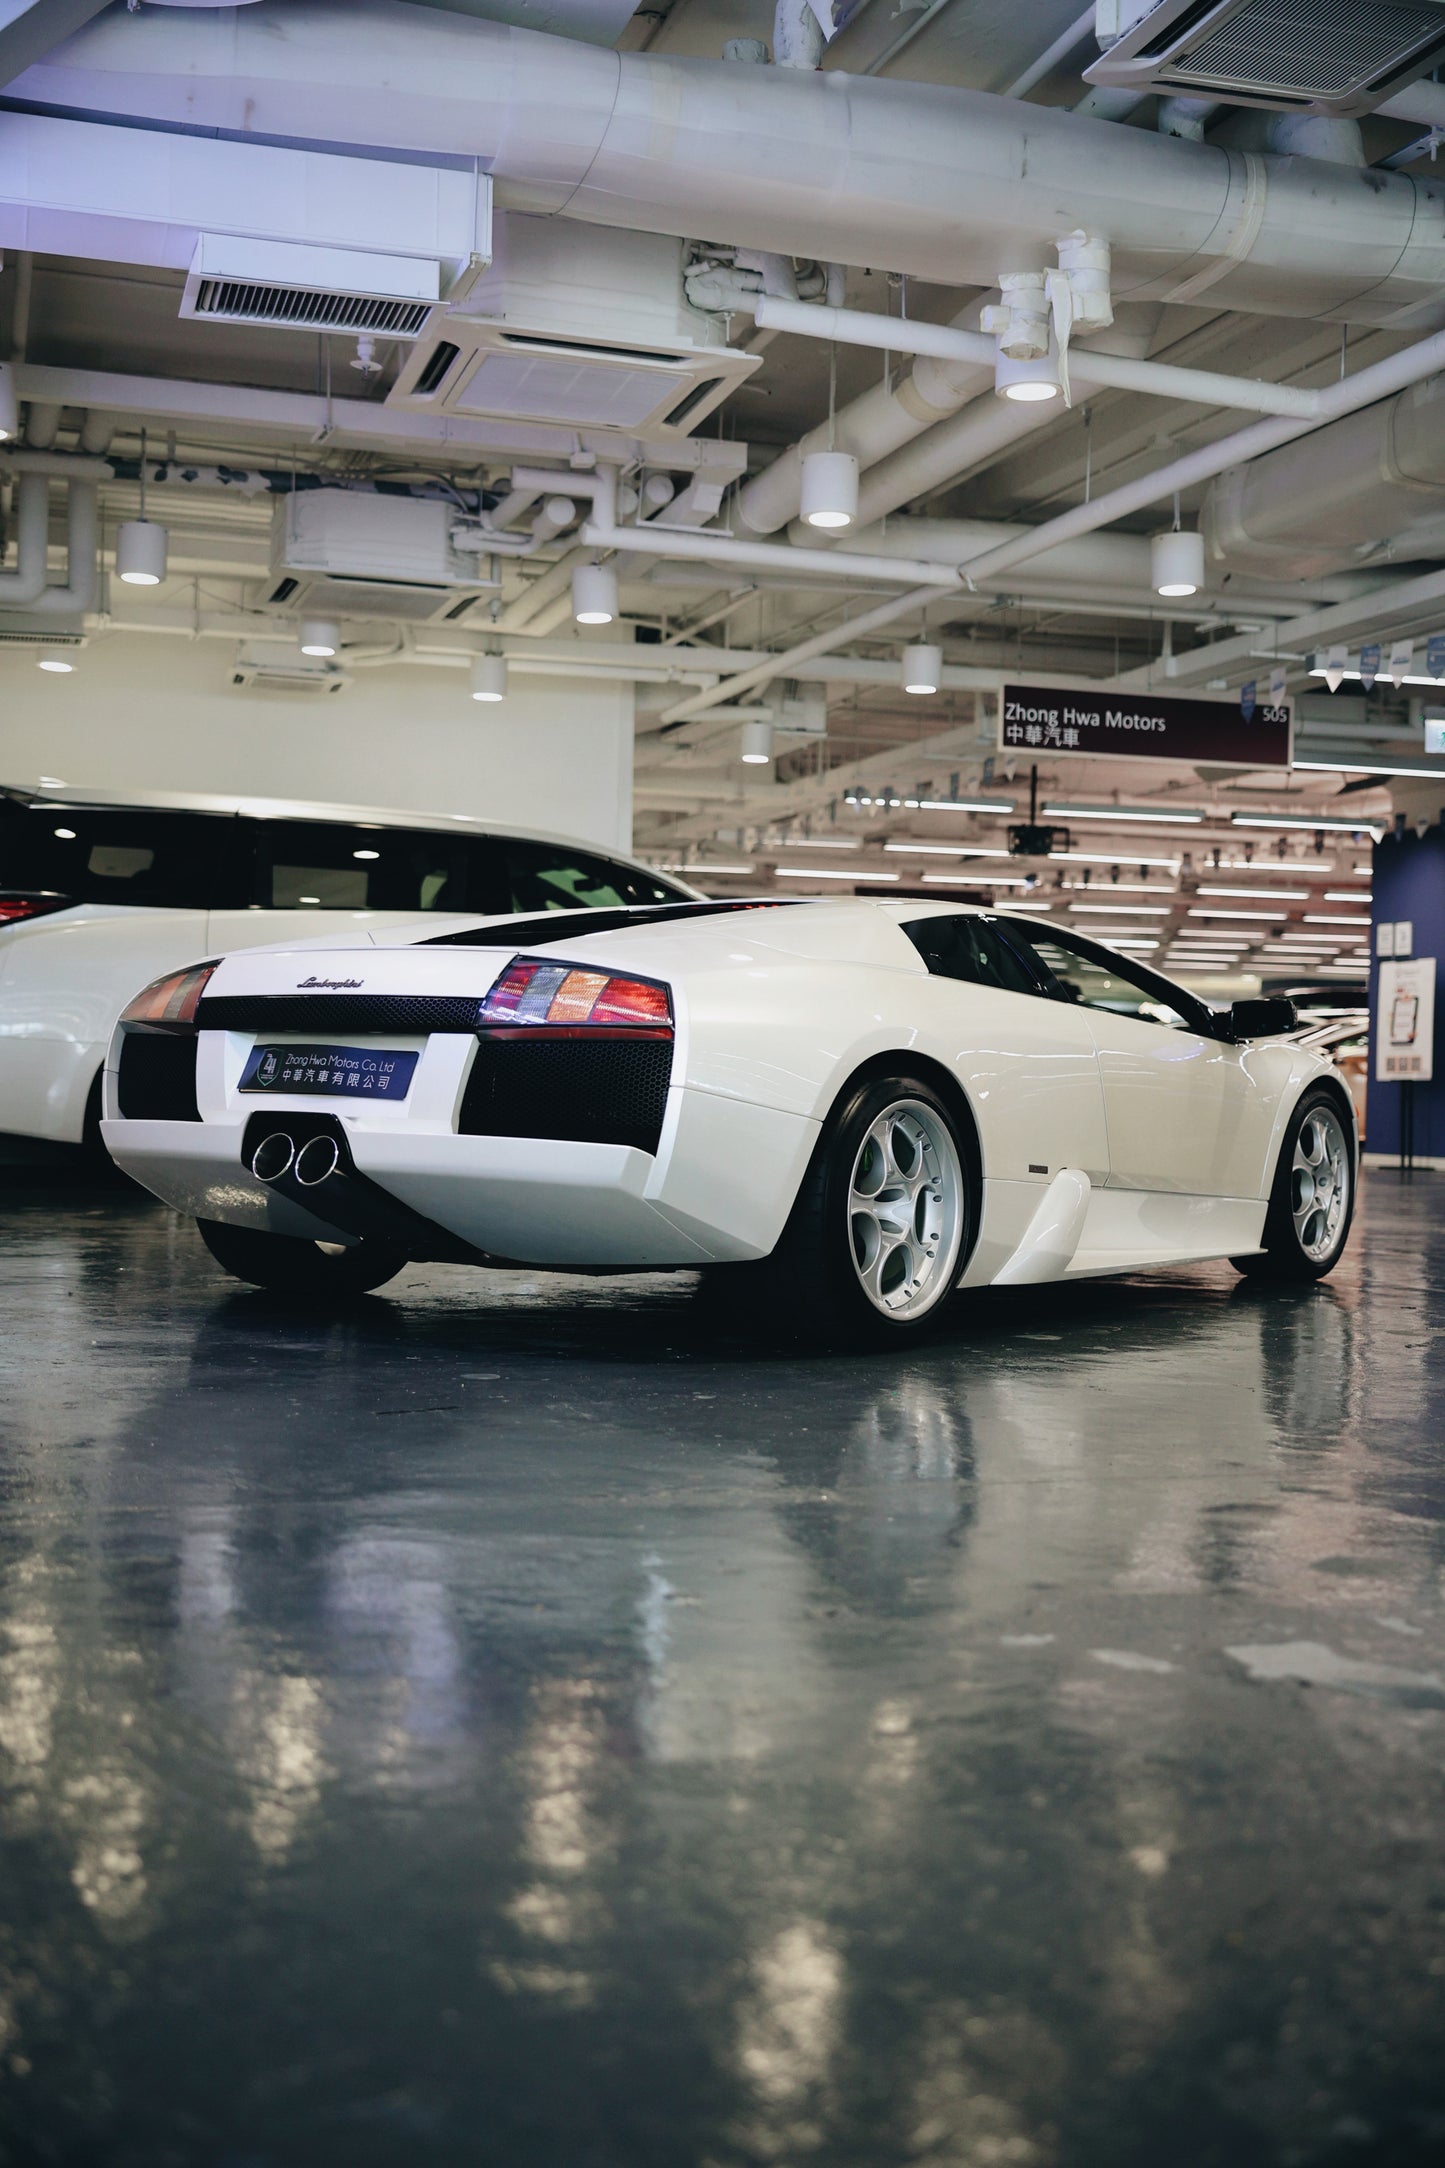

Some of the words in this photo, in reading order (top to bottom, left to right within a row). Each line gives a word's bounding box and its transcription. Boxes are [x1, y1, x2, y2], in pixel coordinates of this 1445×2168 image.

[1005, 702, 1058, 727] Zhong
[1063, 708, 1100, 727] Hwa
[1105, 710, 1166, 732] Motors
[1262, 707, 1288, 723] 505
[1006, 724, 1080, 748] 中華汽車
[309, 1054, 327, 1066] Hwa
[328, 1055, 360, 1069] Motors
[378, 1061, 396, 1073] Ltd
[282, 1068, 391, 1090] 中華汽車有限公司
